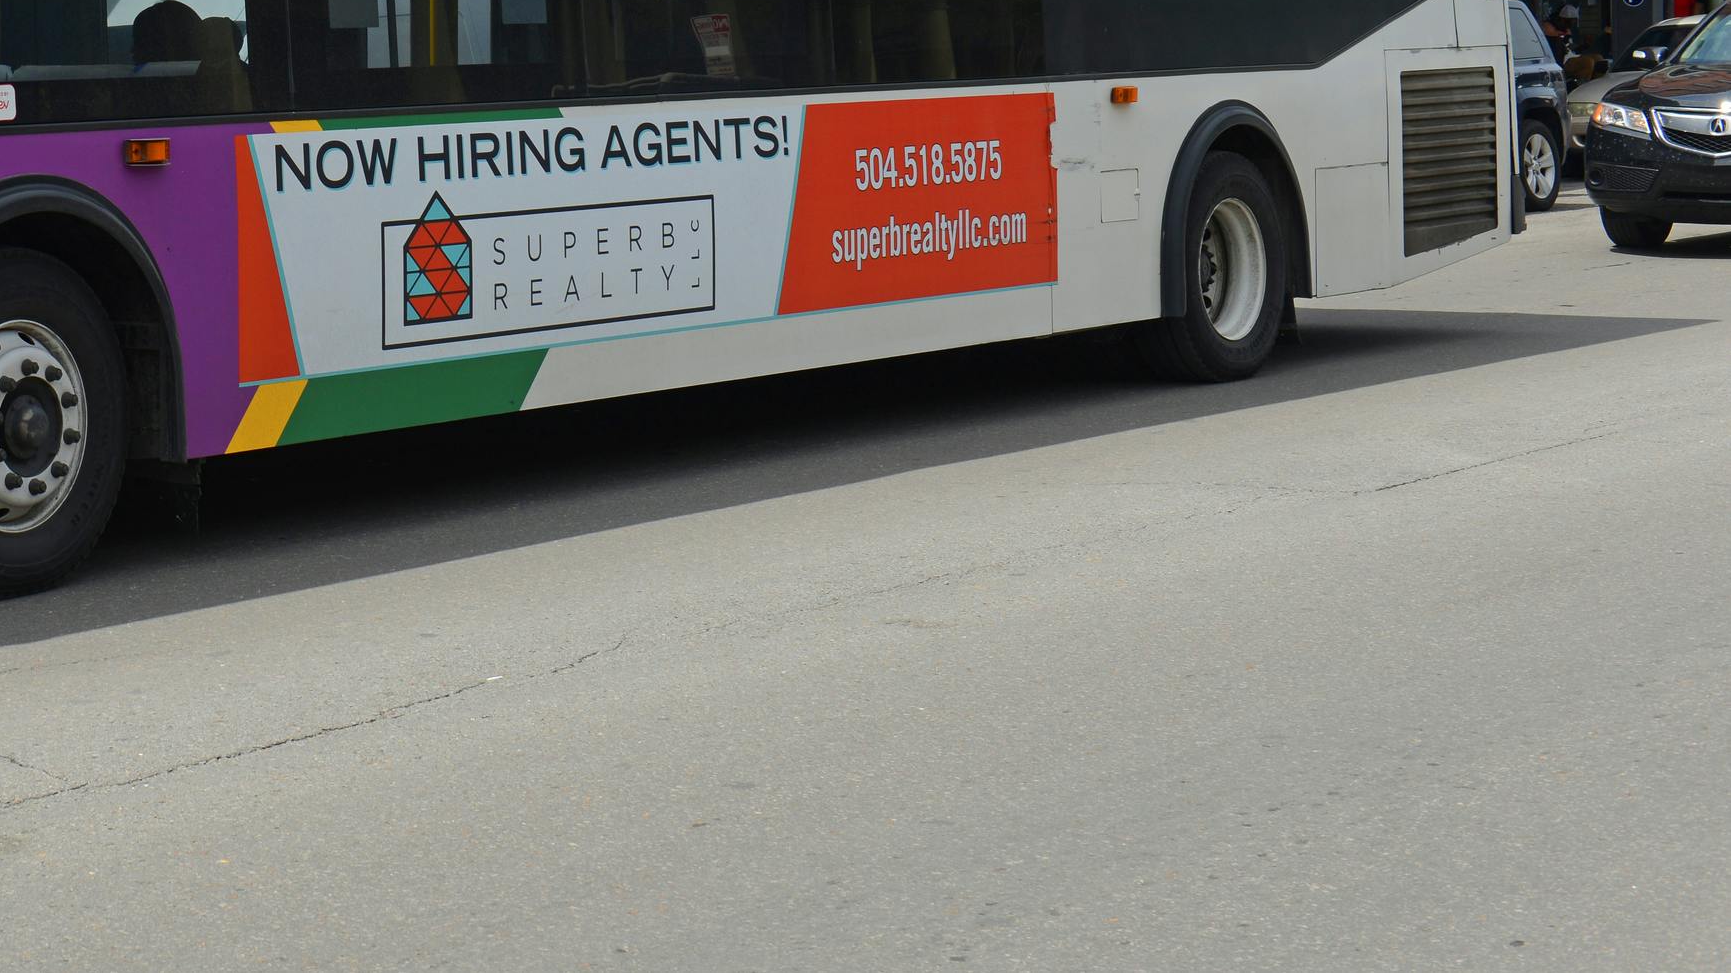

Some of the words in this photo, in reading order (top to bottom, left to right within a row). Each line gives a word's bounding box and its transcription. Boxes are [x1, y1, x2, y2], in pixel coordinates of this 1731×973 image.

[274, 137, 398, 192] NOW
[417, 127, 587, 183] HIRING
[600, 115, 790, 170] AGENTS!
[854, 139, 1003, 192] 504.518.5875
[493, 222, 675, 266] SUPERB
[690, 219, 700, 289] LLC
[831, 209, 1028, 271] superbrealtyllc.com
[493, 264, 675, 311] REALTY
